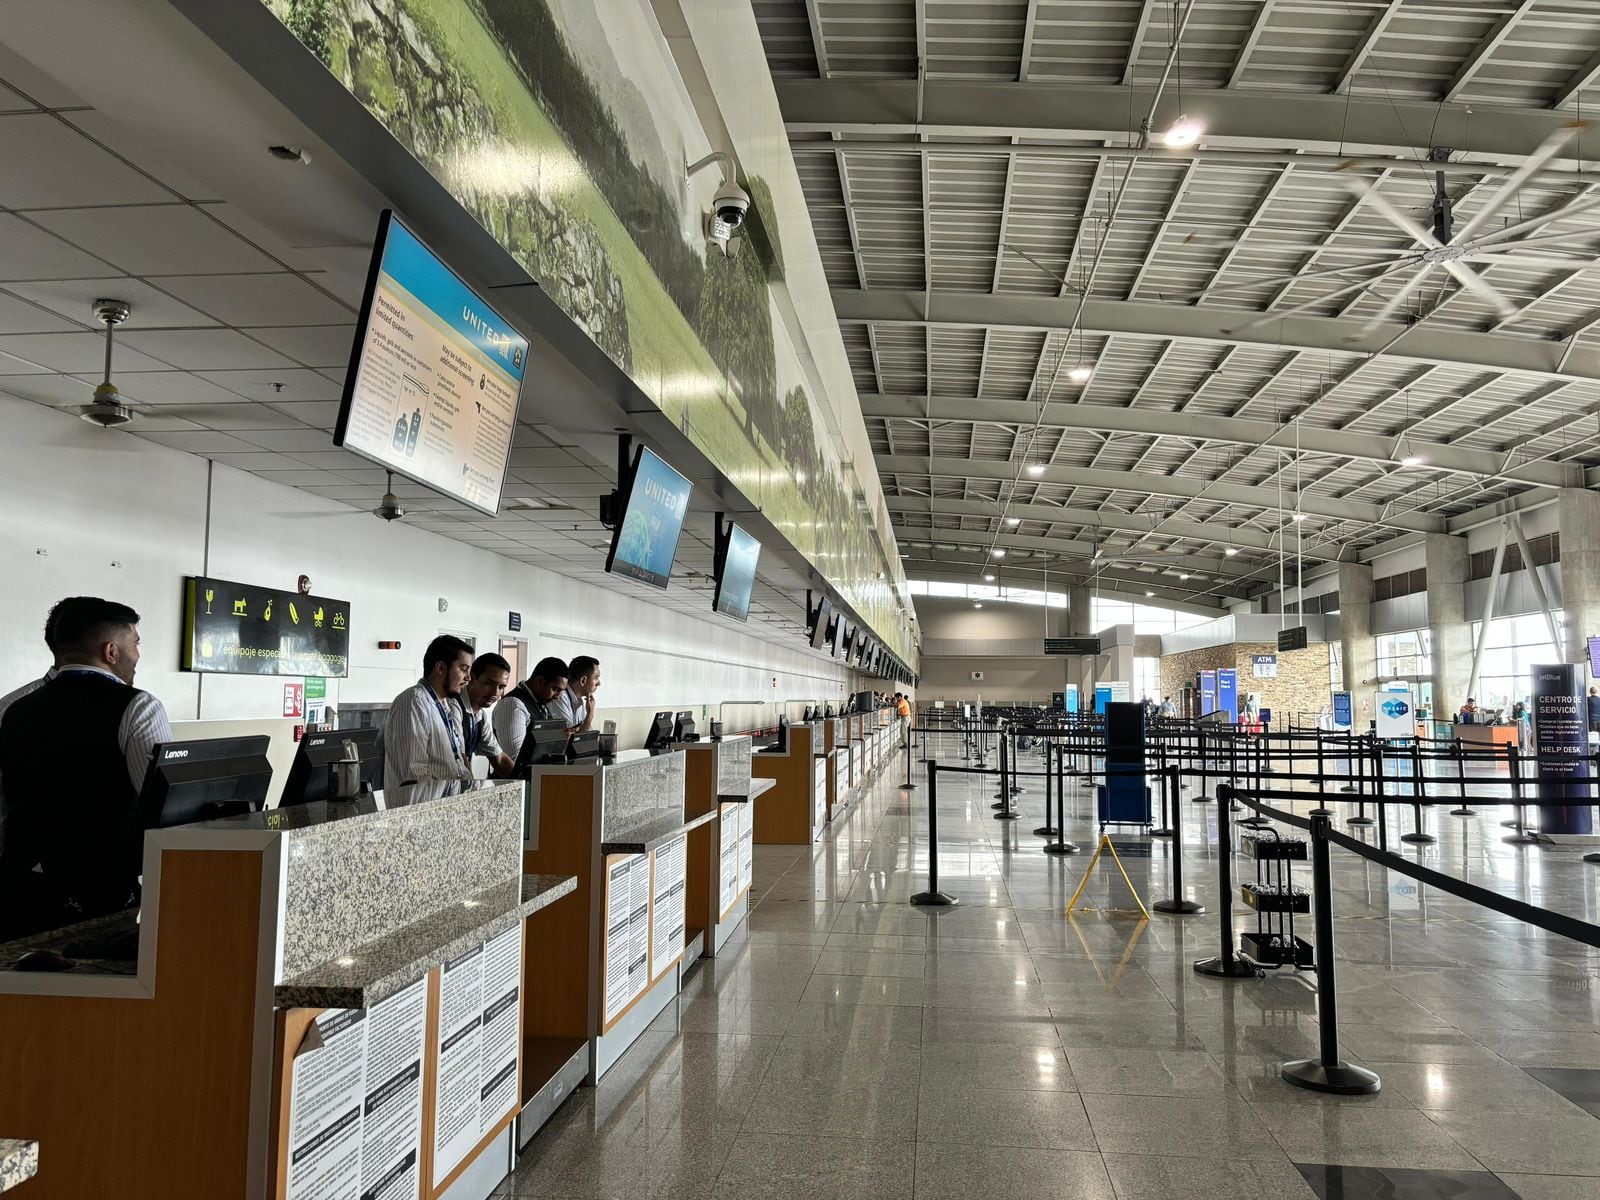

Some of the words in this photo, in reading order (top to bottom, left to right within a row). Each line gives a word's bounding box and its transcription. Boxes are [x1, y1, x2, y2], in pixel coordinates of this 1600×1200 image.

[376, 307, 392, 324] limited
[378, 296, 400, 318] Permitted
[463, 306, 498, 346] UNITED
[645, 478, 677, 510] UNITED
[224, 646, 256, 658] equipaje
[258, 648, 288, 658] especi
[165, 750, 188, 759] Lenovo
